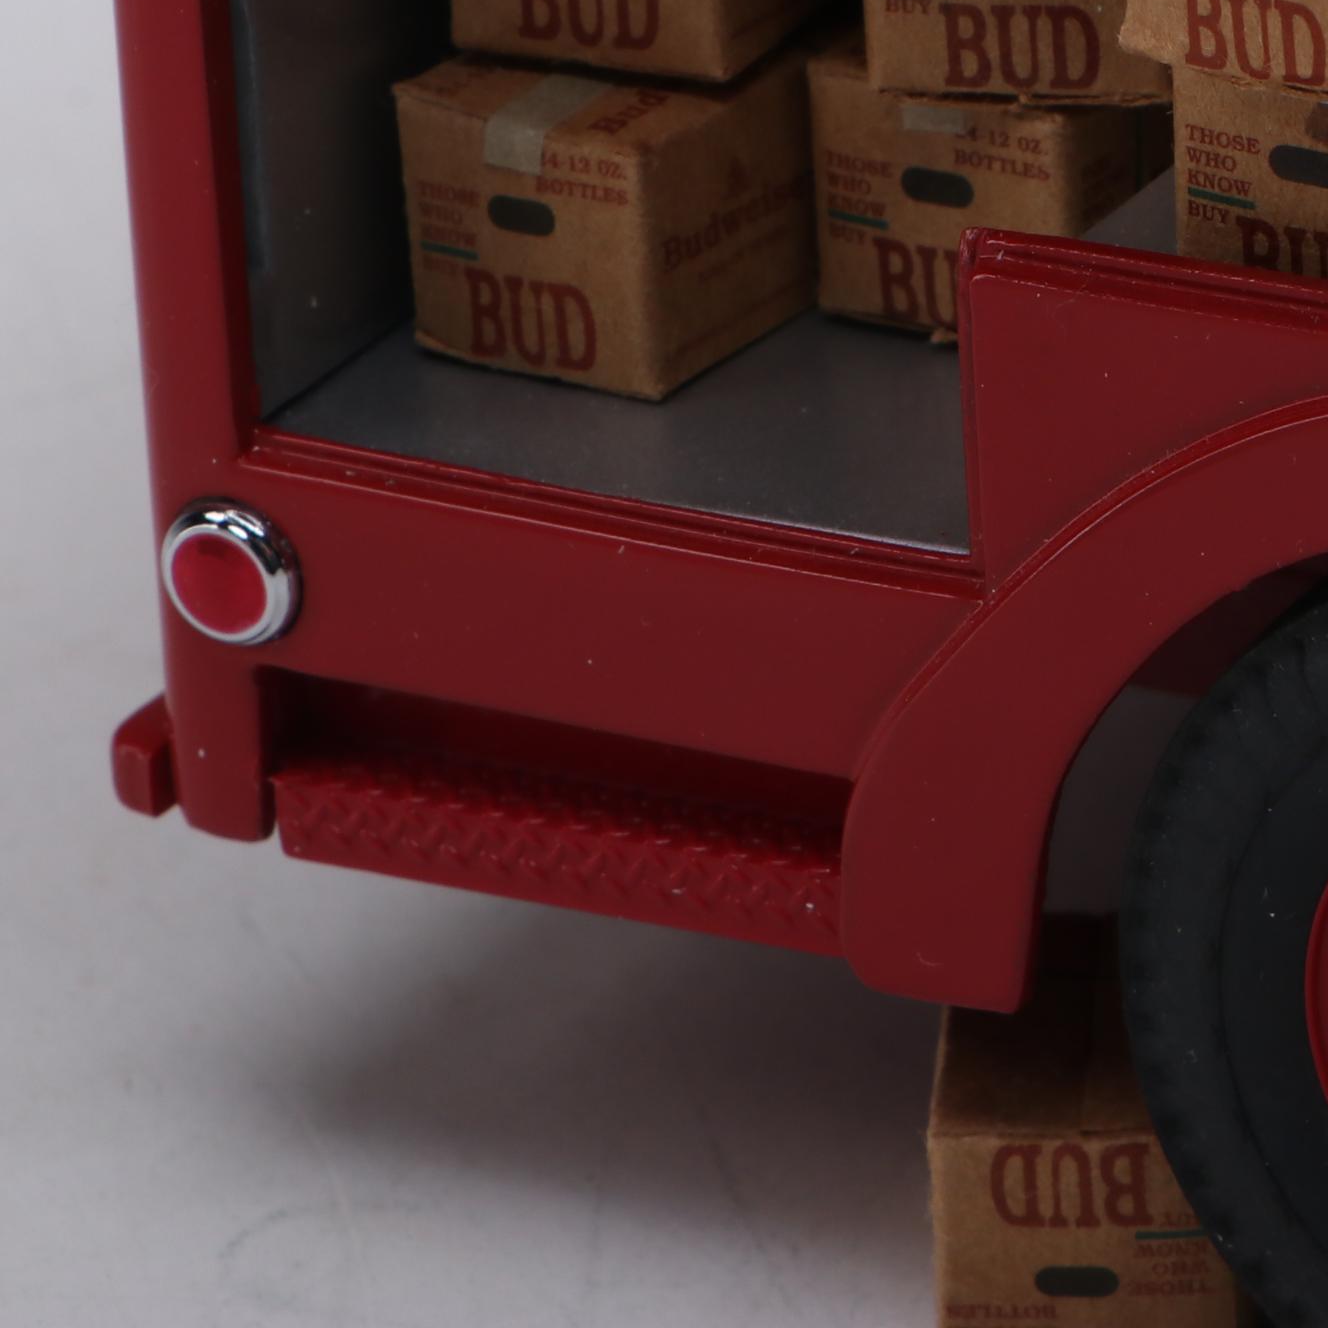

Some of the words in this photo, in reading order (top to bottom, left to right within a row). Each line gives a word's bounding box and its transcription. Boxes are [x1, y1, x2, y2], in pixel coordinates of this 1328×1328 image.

[938, 2, 1101, 90] BUD
[1185, 123, 1261, 156] THOSE
[825, 150, 892, 179] THOSE
[953, 148, 1050, 182] BOTTLES
[1186, 147, 1237, 173] WHO
[535, 175, 629, 207] BOTTLES
[827, 173, 872, 196] WHO
[1187, 170, 1252, 197] KNOW
[420, 201, 464, 226] WHO
[828, 195, 887, 218] KNOW
[1187, 199, 1232, 224] BUY
[829, 223, 868, 245] BUY
[872, 236, 959, 332] BU
[464, 267, 598, 372] BUD
[990, 1141, 1154, 1229] BUD
